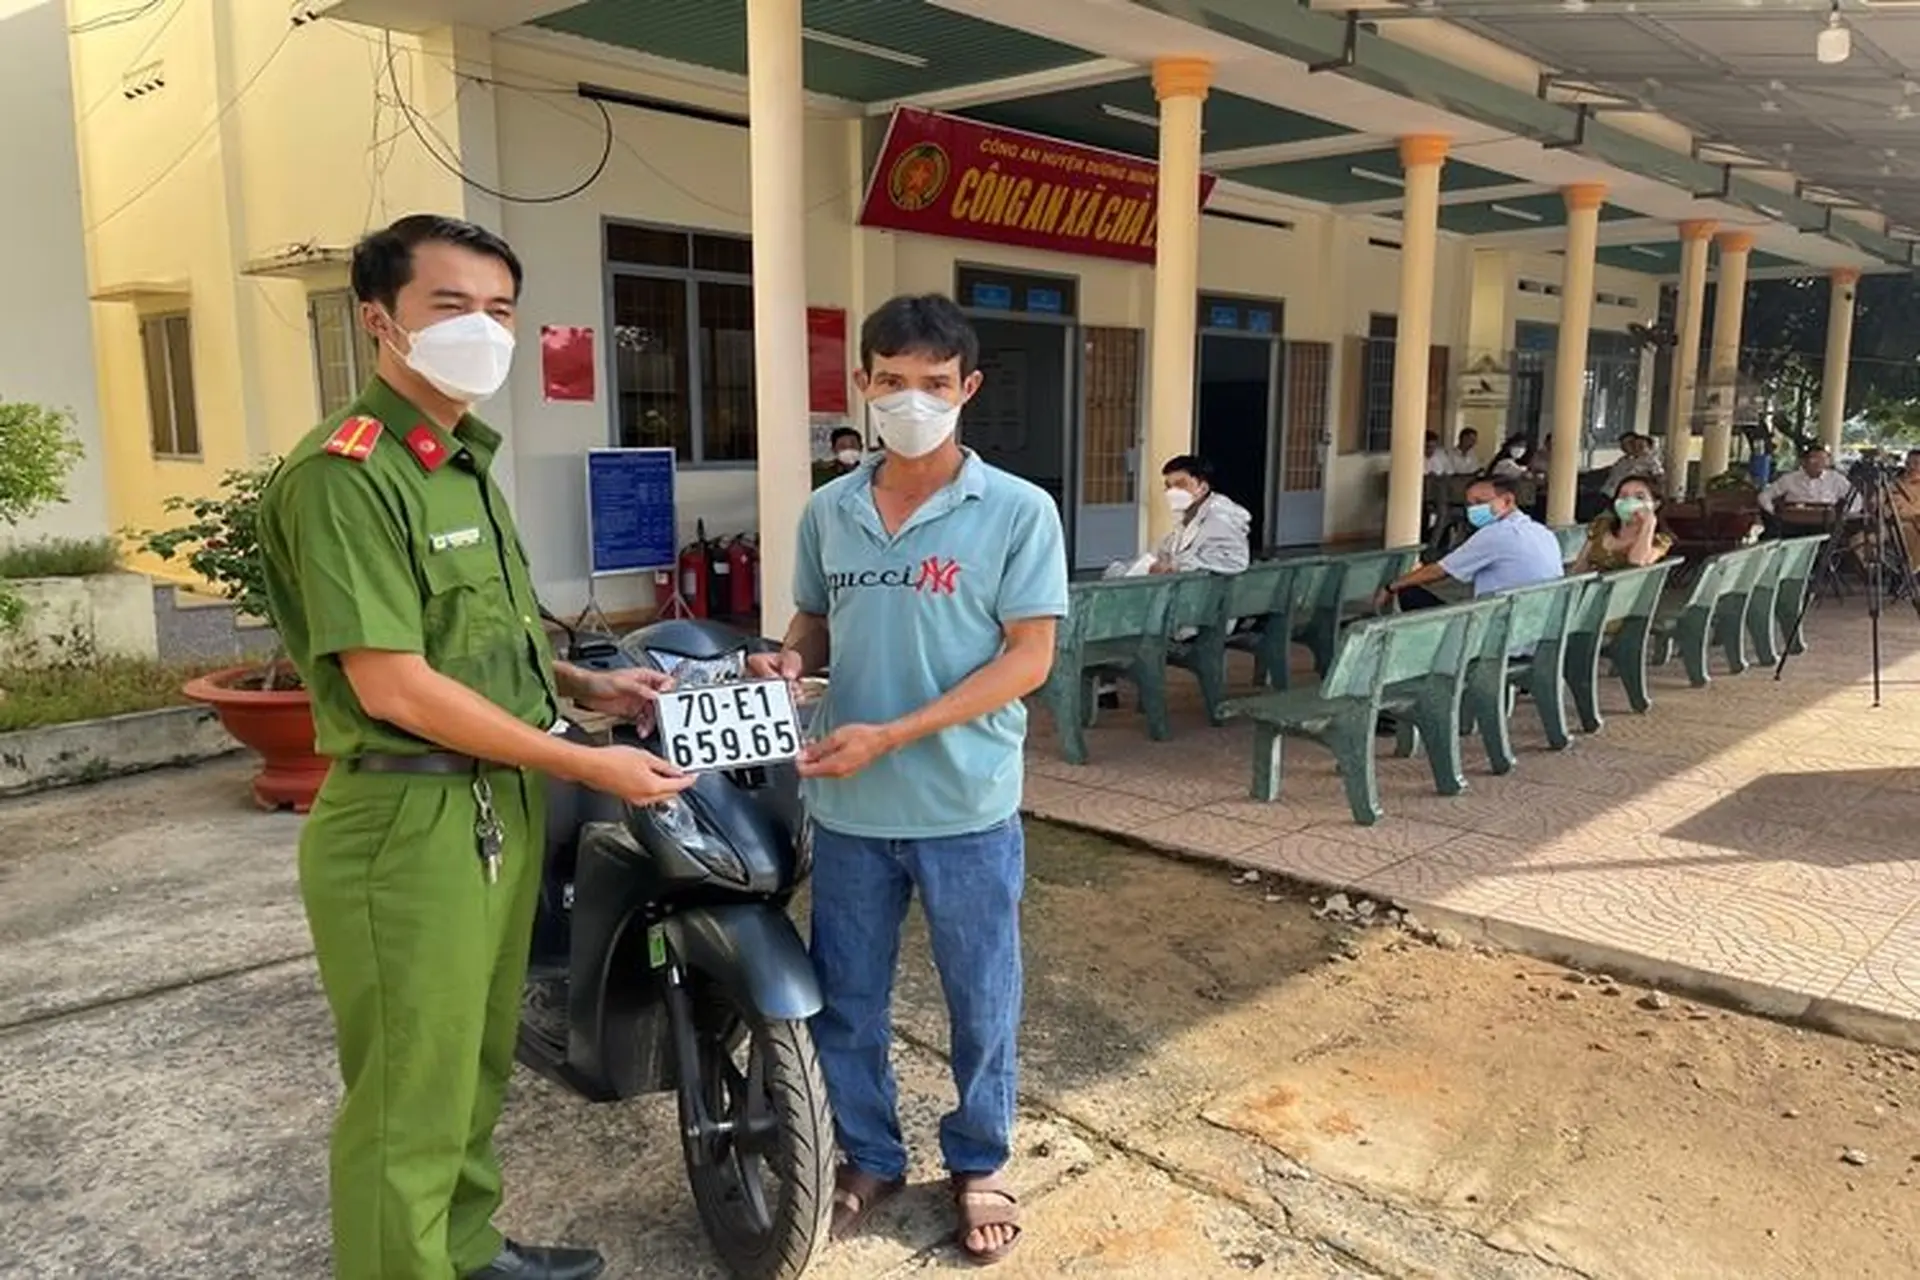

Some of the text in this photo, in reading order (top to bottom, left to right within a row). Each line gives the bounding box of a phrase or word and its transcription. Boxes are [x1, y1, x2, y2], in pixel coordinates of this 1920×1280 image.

[1020, 147, 1040, 161] AN
[951, 161, 1033, 225] CÔNG
[1020, 182, 1070, 235] AN
[1057, 183, 1107, 237] XÃ
[1140, 213, 1159, 248] L
[677, 685, 771, 728] 70-E1
[672, 720, 795, 767] 659.65
